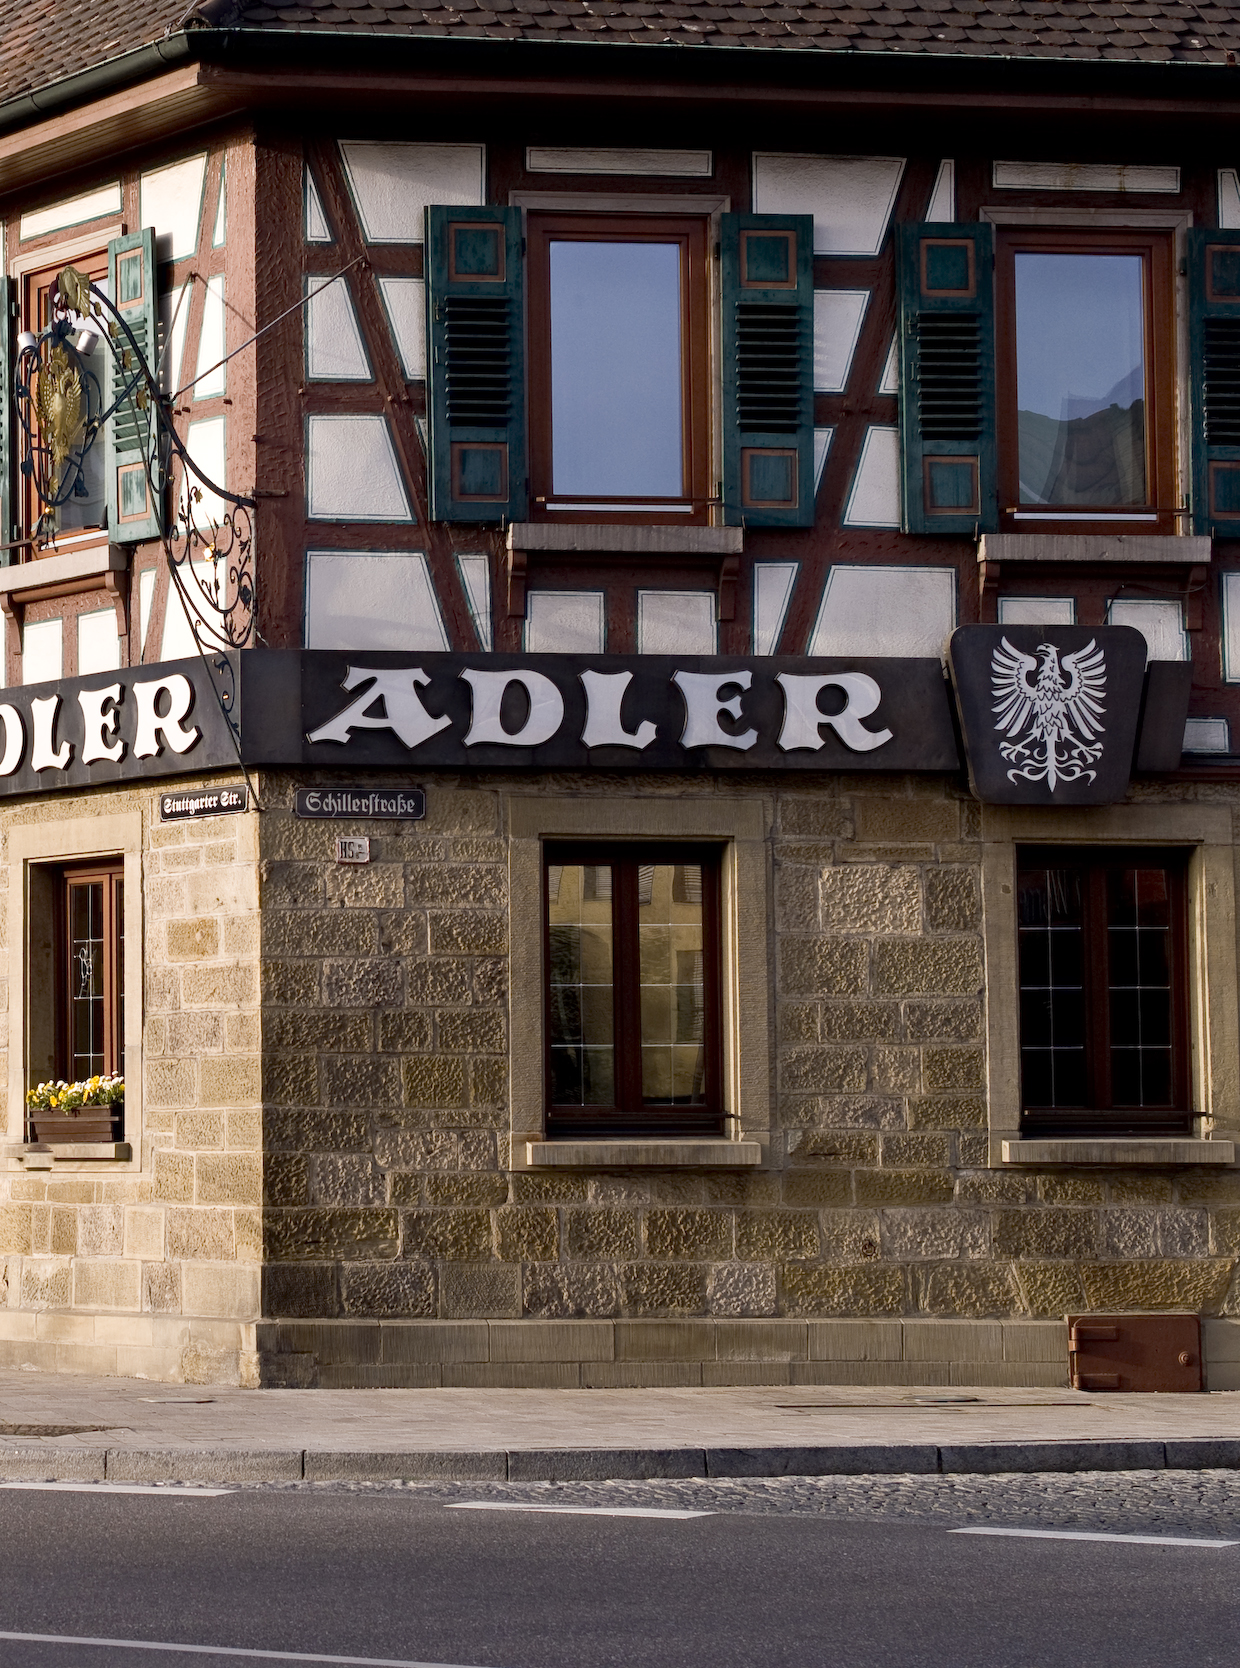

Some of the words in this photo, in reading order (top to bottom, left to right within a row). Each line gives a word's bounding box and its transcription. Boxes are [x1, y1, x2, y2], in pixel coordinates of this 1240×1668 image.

[306, 665, 894, 752] ADLER
[163, 794, 219, 815] Stuttgarter
[220, 791, 242, 807] Str.
